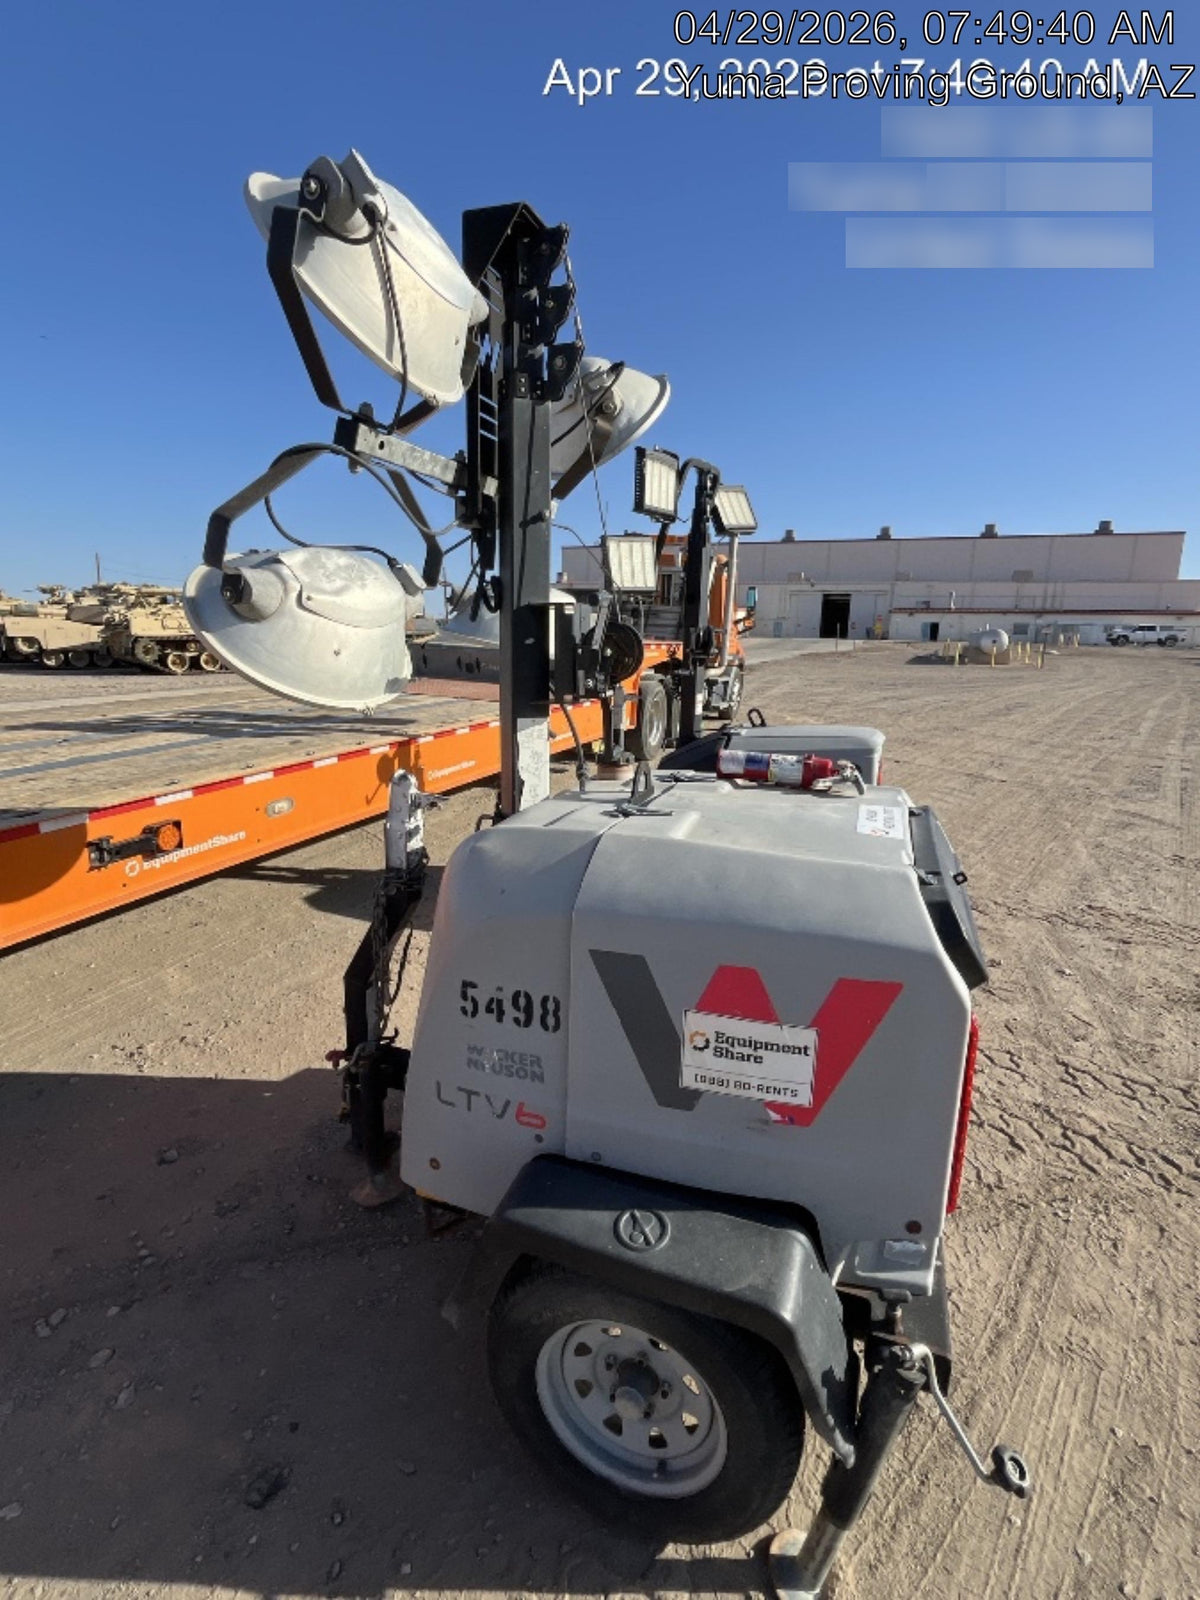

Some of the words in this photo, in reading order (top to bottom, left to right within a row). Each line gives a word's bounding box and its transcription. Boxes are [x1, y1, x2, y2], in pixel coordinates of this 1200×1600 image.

[459, 979, 561, 1034] 5498
[466, 1043, 544, 1069] WCKER
[712, 1045, 764, 1064] Share
[713, 1030, 810, 1057] Equipment
[436, 1080, 546, 1130] LTV6
